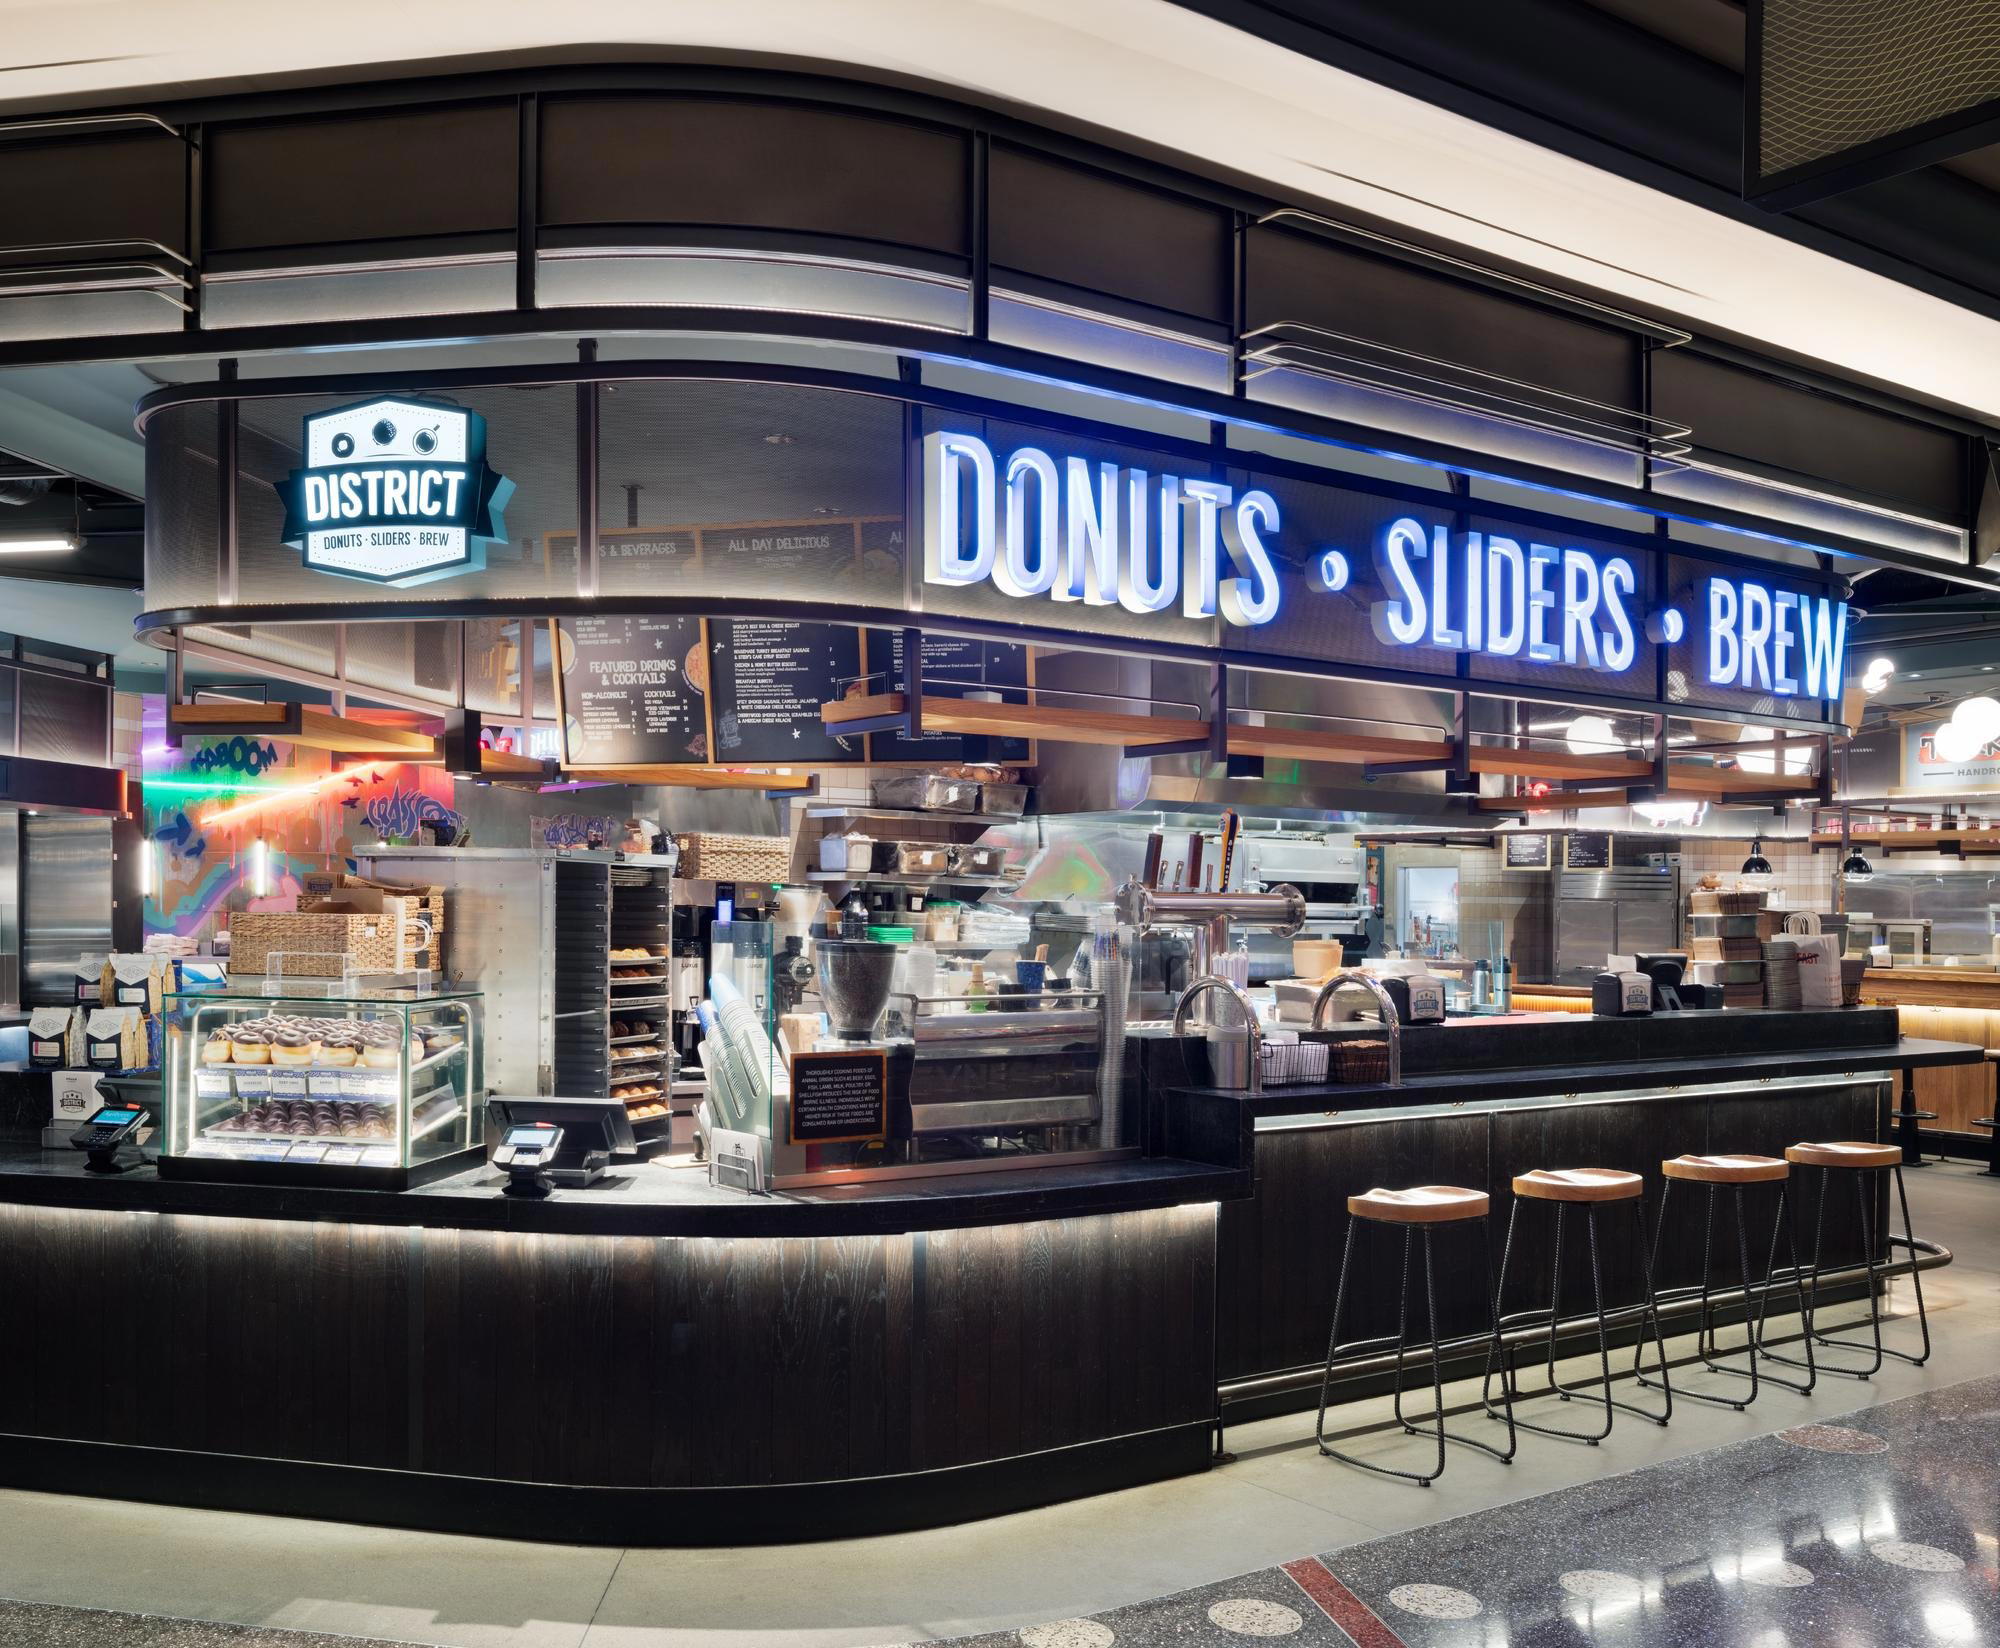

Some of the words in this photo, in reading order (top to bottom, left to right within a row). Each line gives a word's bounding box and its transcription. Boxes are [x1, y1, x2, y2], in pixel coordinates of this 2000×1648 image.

[304, 469, 466, 522] DISTRICT
[324, 534, 362, 550] DONUTS
[371, 532, 411, 547] SLIDERS
[420, 532, 449, 547] BREW
[728, 539, 749, 552] ALL
[752, 538, 772, 551] DAY
[621, 543, 676, 556] BEVERAGES
[922, 430, 1281, 627] DONUTS
[1371, 517, 1637, 673] SLIDERS
[1706, 576, 1848, 701] BREW
[590, 661, 637, 674] FEATURED
[640, 659, 677, 672] DRINKS
[602, 674, 610, 686] &
[613, 673, 667, 686] COCKTAILS
[581, 691, 628, 700] NON-ALCOHOLIC
